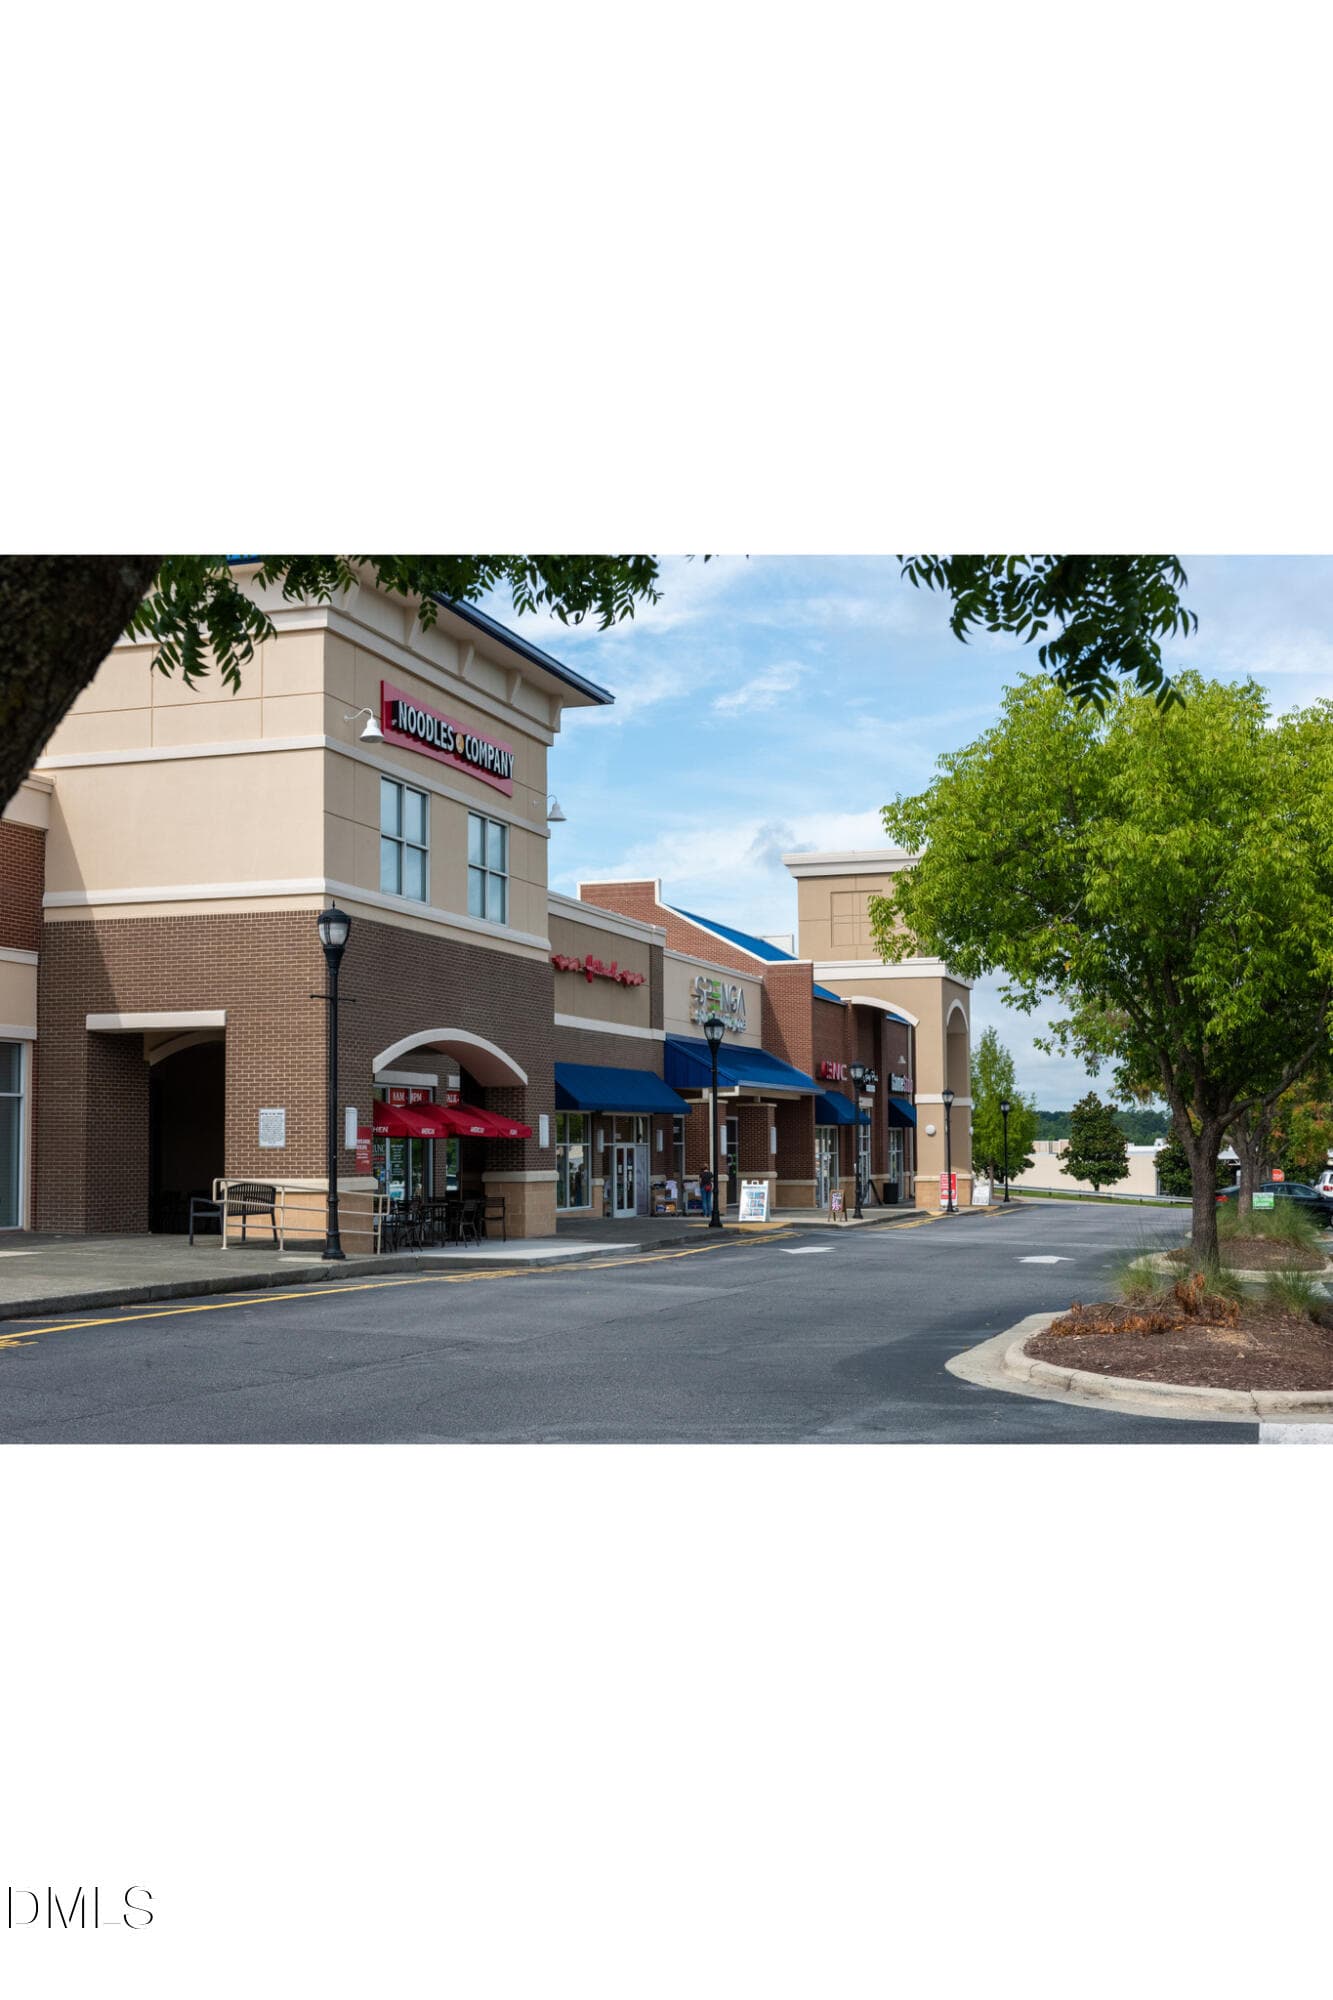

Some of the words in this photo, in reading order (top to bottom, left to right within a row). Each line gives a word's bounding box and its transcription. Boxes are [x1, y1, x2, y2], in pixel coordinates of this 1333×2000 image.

[398, 700, 455, 752] NOODLES
[465, 734, 515, 780] COMPANY
[694, 975, 746, 1017] SPENGA
